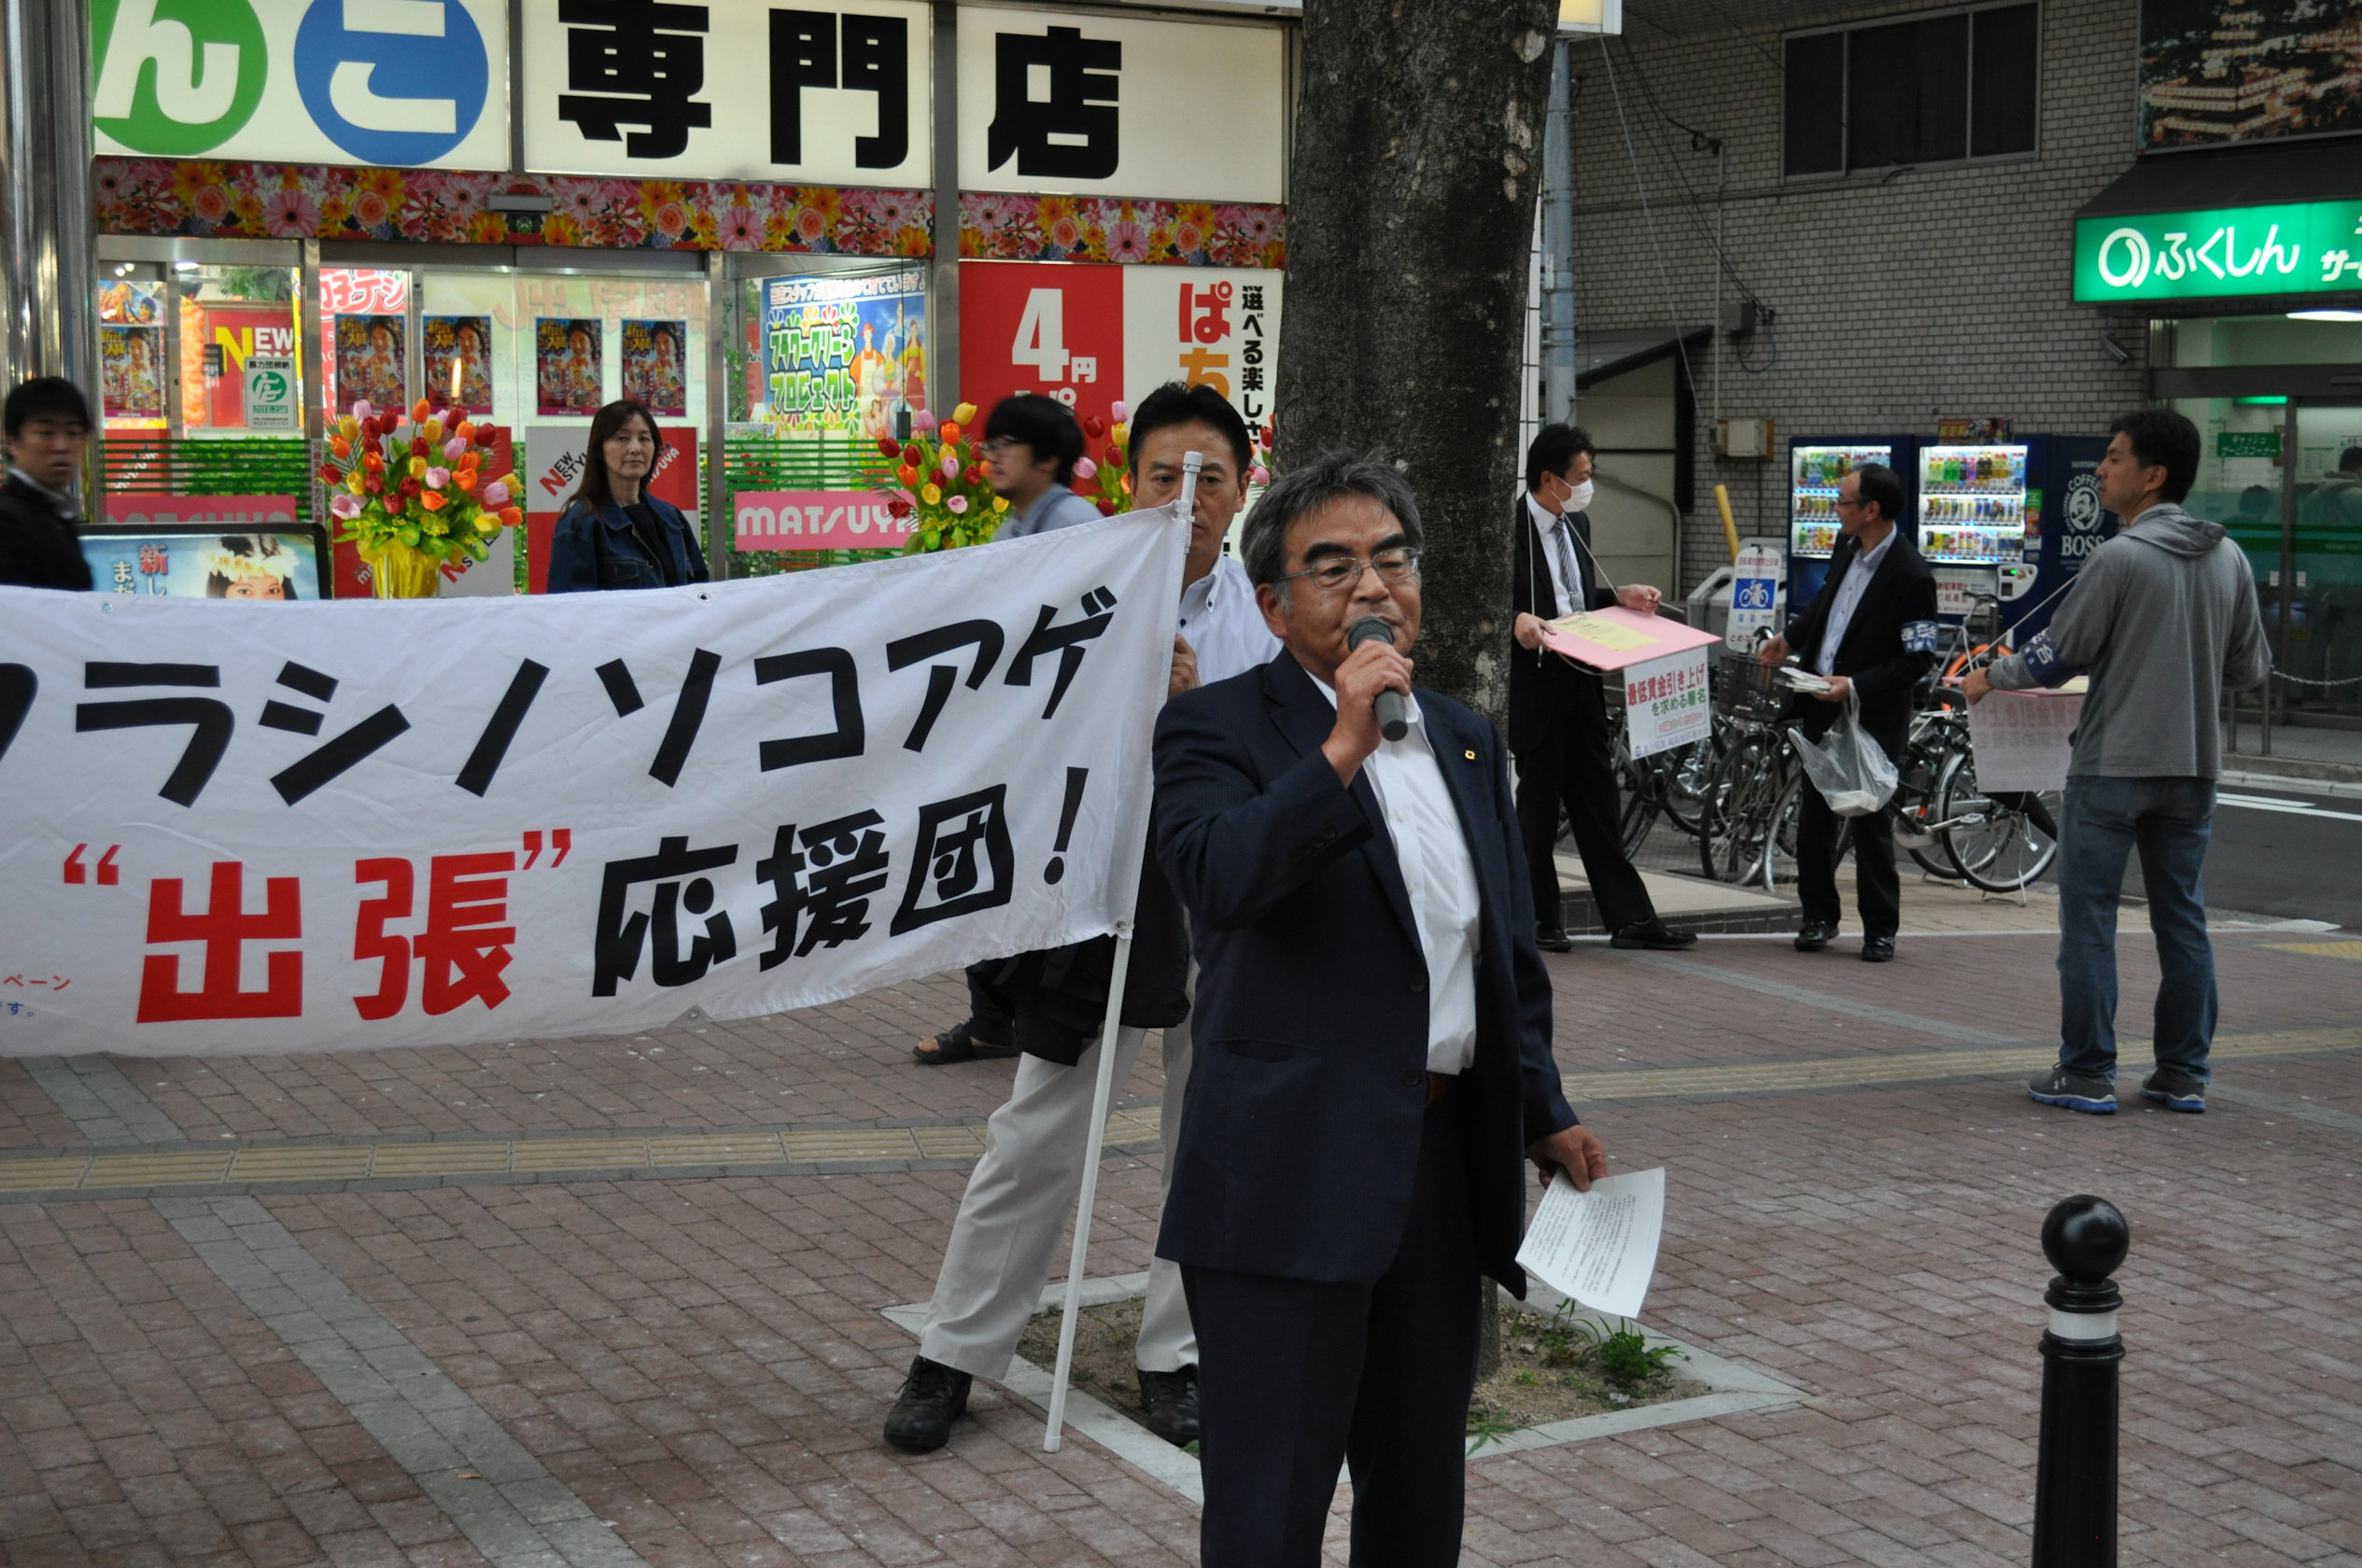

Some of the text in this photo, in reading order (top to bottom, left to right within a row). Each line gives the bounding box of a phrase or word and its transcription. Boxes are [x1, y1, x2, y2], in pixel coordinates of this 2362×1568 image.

[2155, 224, 2300, 281] ふくしん
[1012, 287, 1097, 383] 4円
[769, 368, 856, 413] プロジェクト
[2061, 535, 2104, 557] BOSS
[1627, 664, 1706, 707] 最低賃金引き上げ
[1651, 689, 1707, 717] を求める署名
[3, 973, 71, 991] ペーン
[0, 1001, 35, 1017] す。
